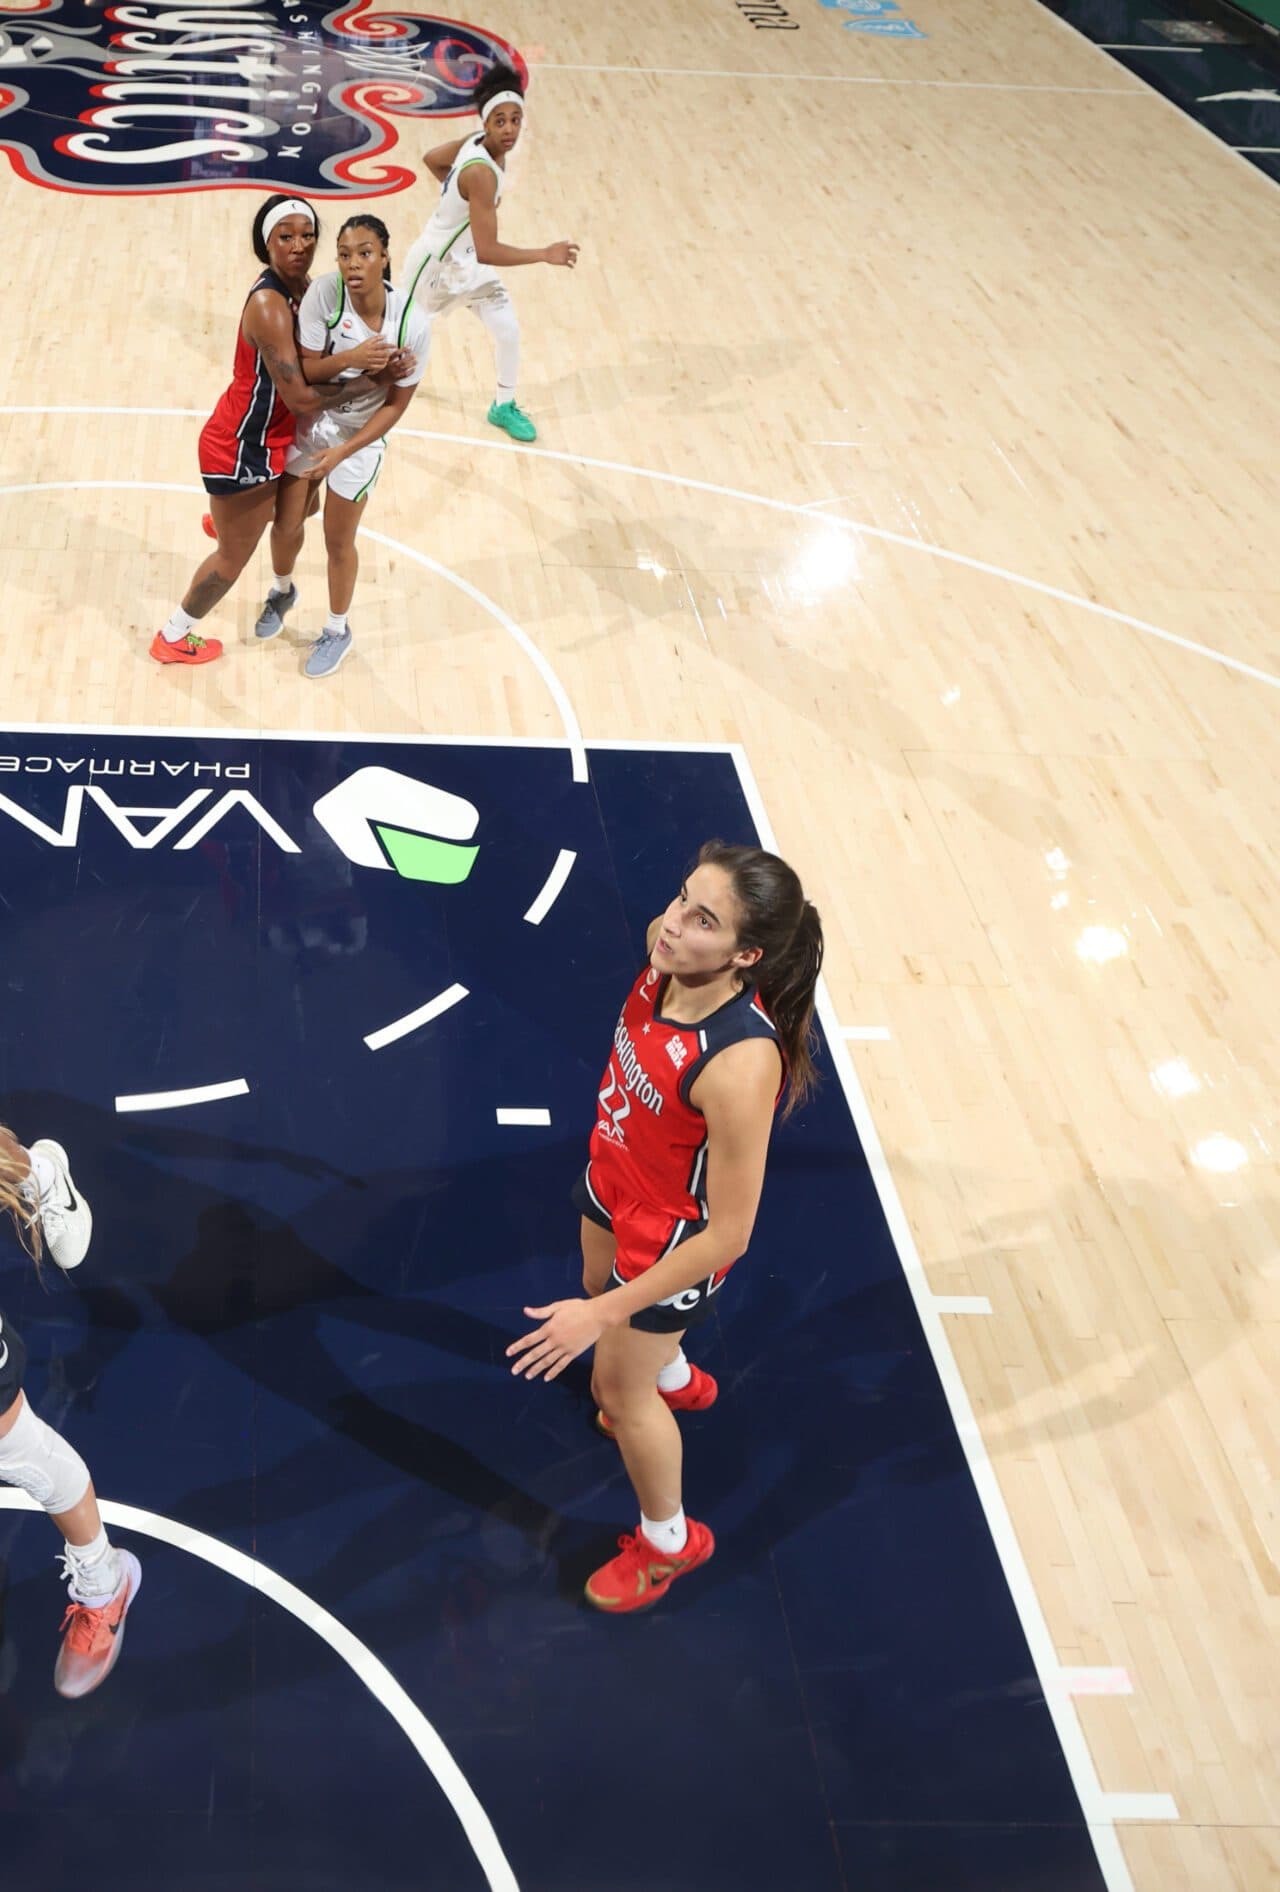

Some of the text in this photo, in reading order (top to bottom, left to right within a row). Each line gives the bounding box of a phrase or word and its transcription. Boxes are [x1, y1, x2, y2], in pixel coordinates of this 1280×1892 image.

[67, 0, 289, 163] ystics
[277, 0, 322, 158] ASHINGTON
[614, 1005, 663, 1116] ashington
